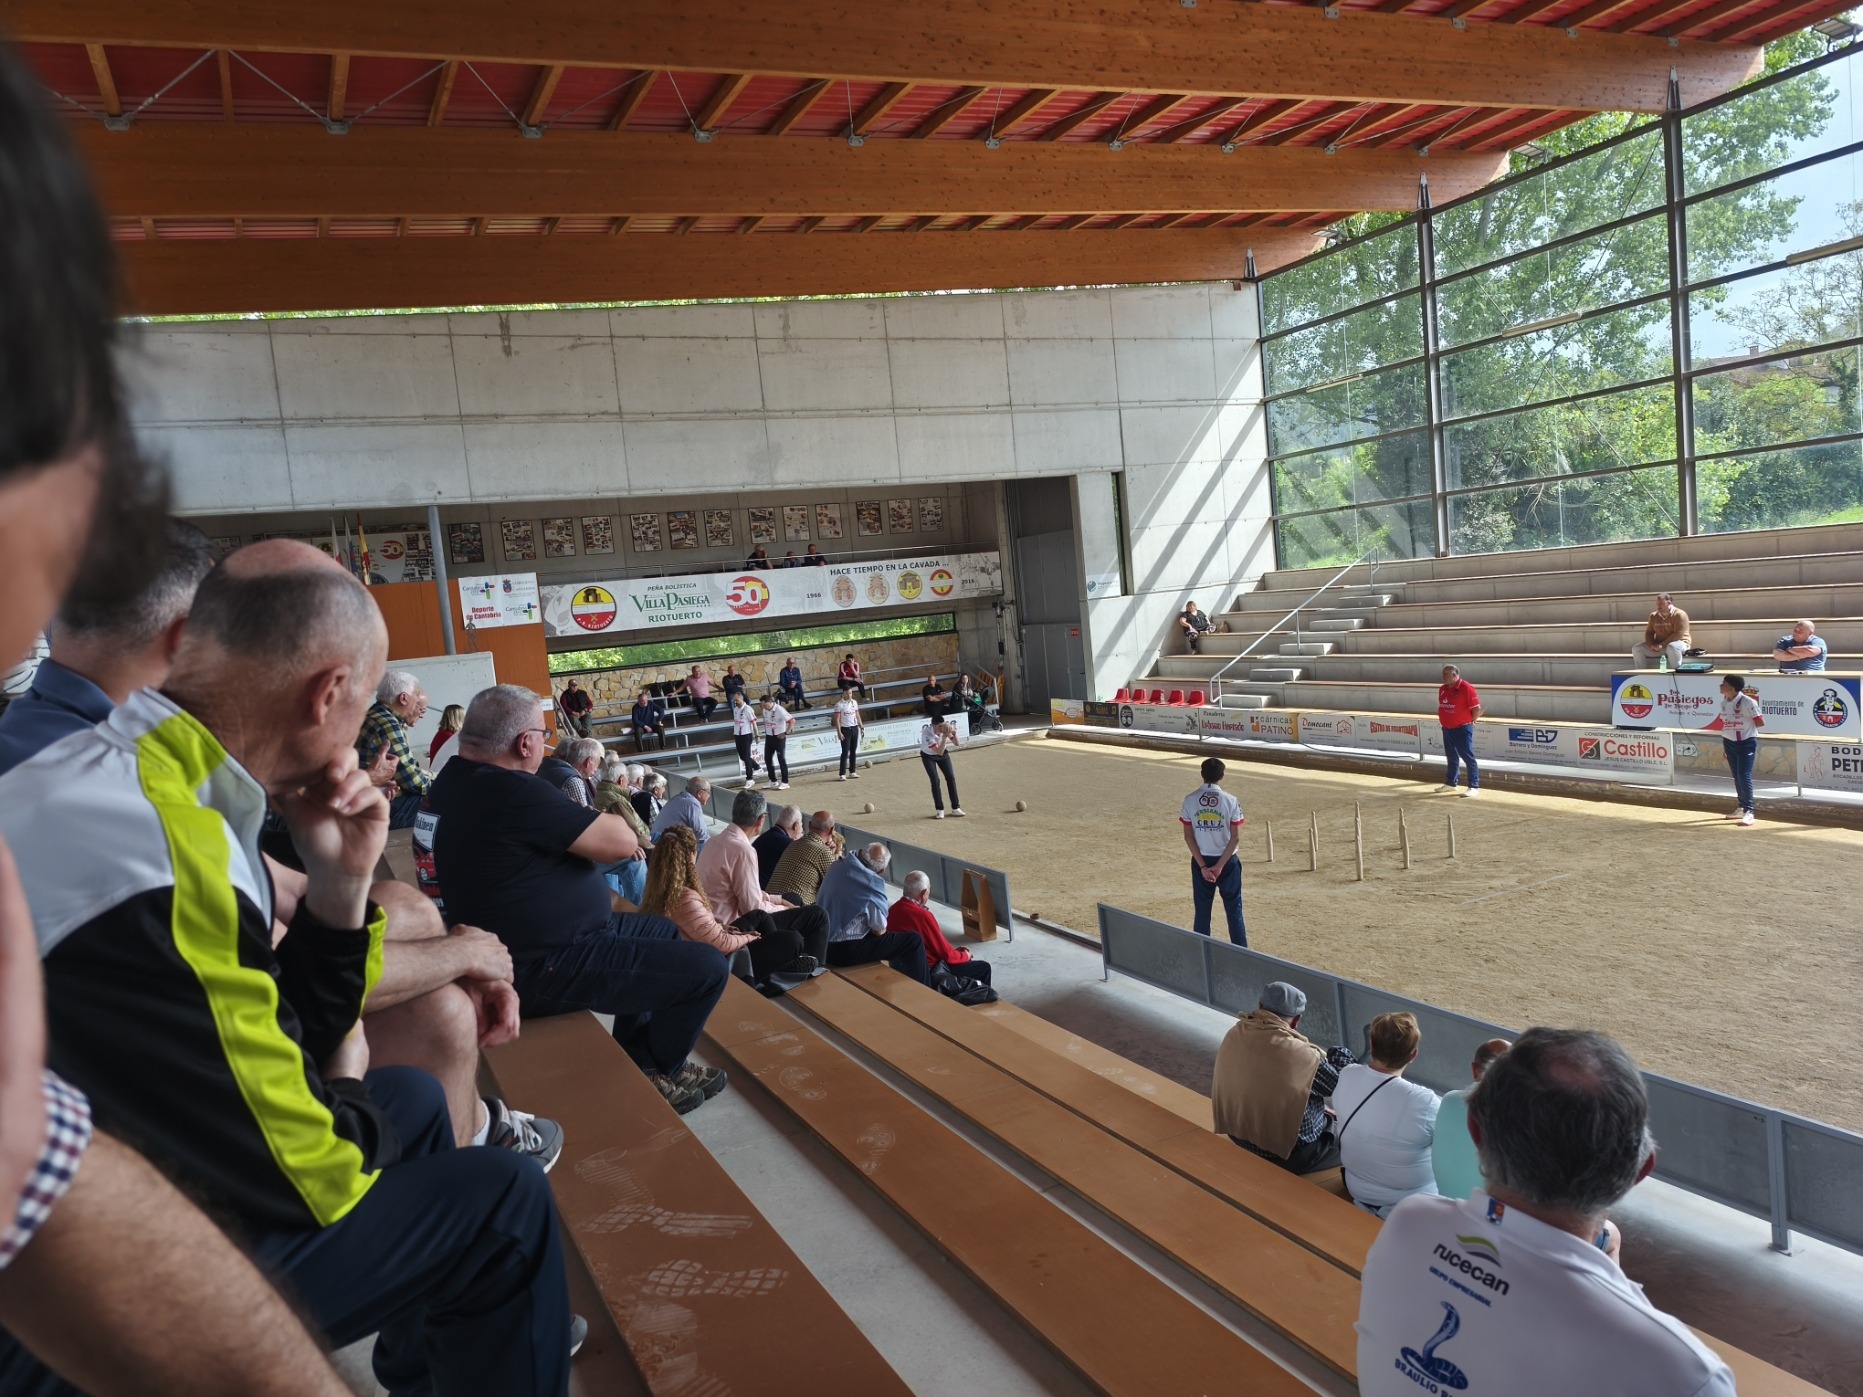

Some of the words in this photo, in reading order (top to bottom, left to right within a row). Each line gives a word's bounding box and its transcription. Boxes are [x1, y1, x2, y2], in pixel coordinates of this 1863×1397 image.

[830, 568, 851, 576] HACE
[853, 565, 883, 574] TIEMPO
[910, 561, 940, 569] CAVADA
[726, 581, 762, 606] 50
[648, 612, 703, 623] RIOTUERTO
[1657, 694, 1714, 709] Pasiegos
[1761, 706, 1797, 715] RIOTUERTO
[1604, 740, 1668, 758] Castillo
[1832, 758, 1863, 773] PET
[1433, 1243, 1511, 1296] rucecan
[1395, 1358, 1439, 1395] BRAULIO
